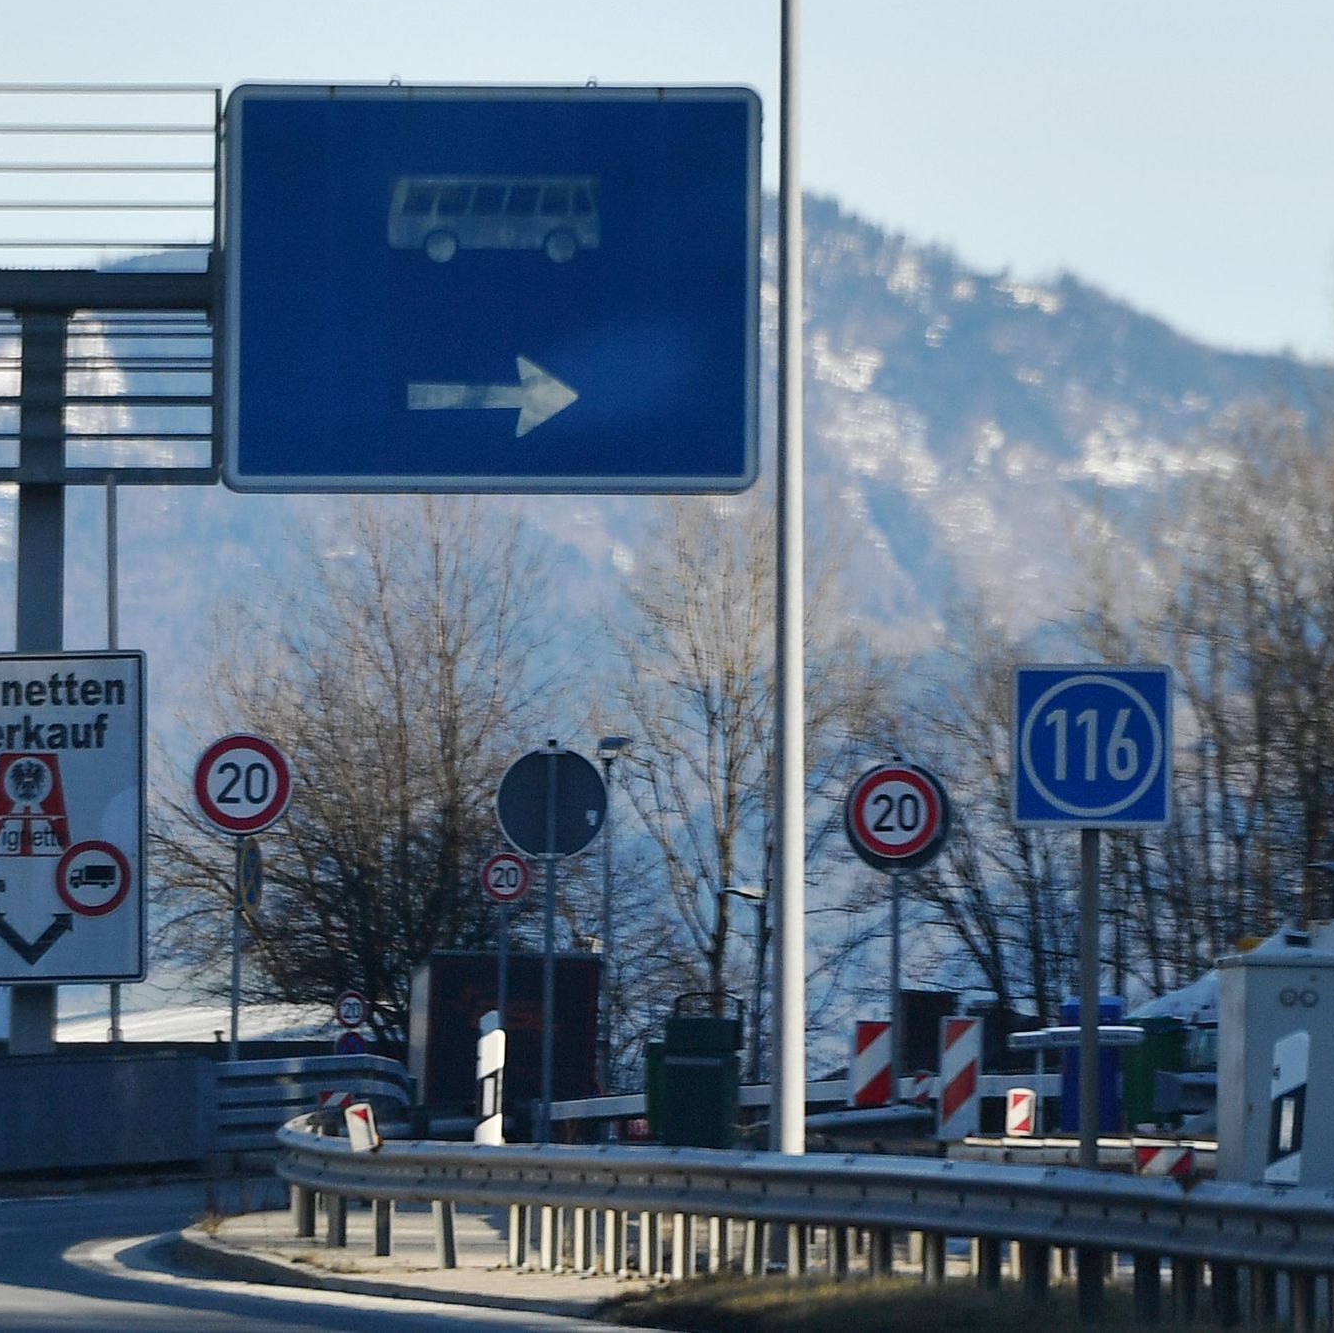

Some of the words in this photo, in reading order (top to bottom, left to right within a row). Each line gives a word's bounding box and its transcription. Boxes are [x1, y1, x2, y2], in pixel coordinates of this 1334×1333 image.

[1044, 708, 1139, 782] 116
[216, 762, 269, 805] 20
[872, 793, 920, 833] 20
[492, 866, 519, 888] 20
